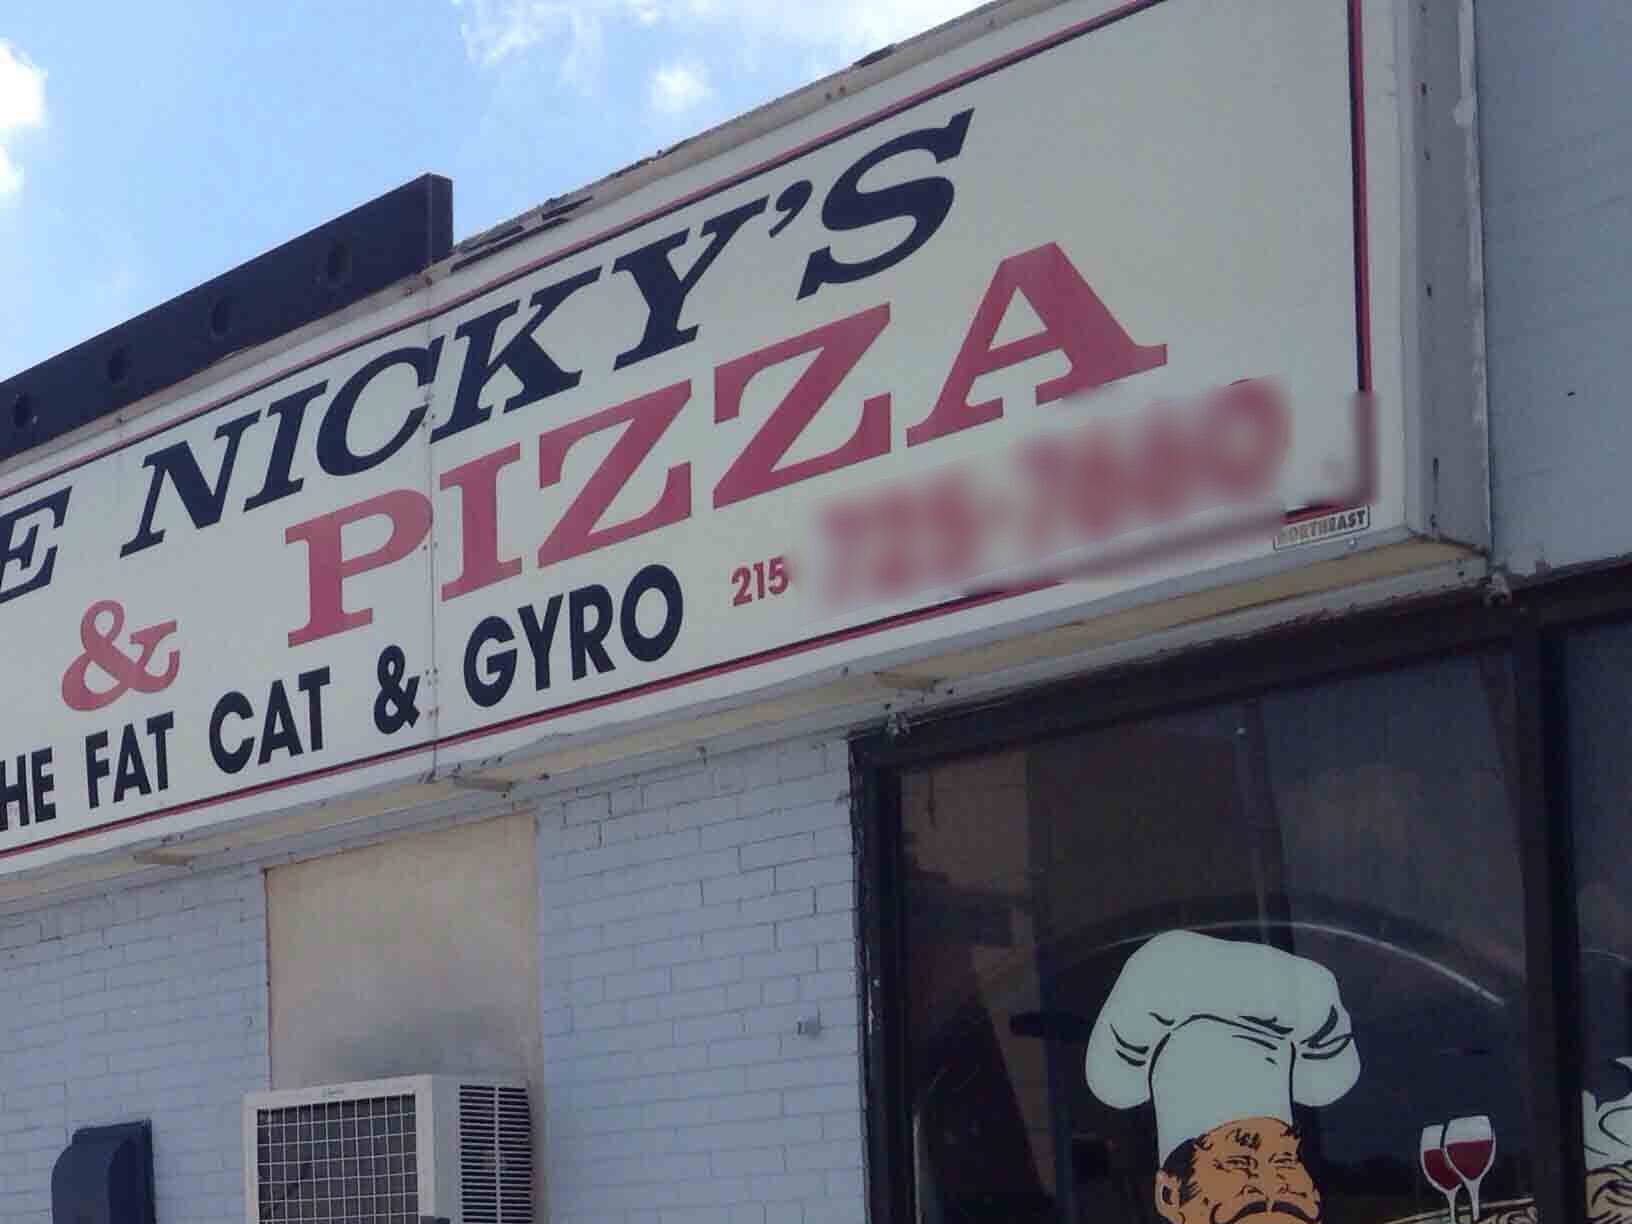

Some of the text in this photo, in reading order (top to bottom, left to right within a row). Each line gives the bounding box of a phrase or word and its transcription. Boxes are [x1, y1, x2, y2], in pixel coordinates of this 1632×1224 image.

[62, 600, 181, 711] &
[285, 241, 1168, 647] PIZZA
[119, 107, 975, 557] NICKY'S
[85, 711, 175, 809] FAT
[209, 666, 332, 774] CAT
[374, 645, 420, 735] &
[464, 563, 684, 707] GYRO
[730, 555, 790, 607] 215
